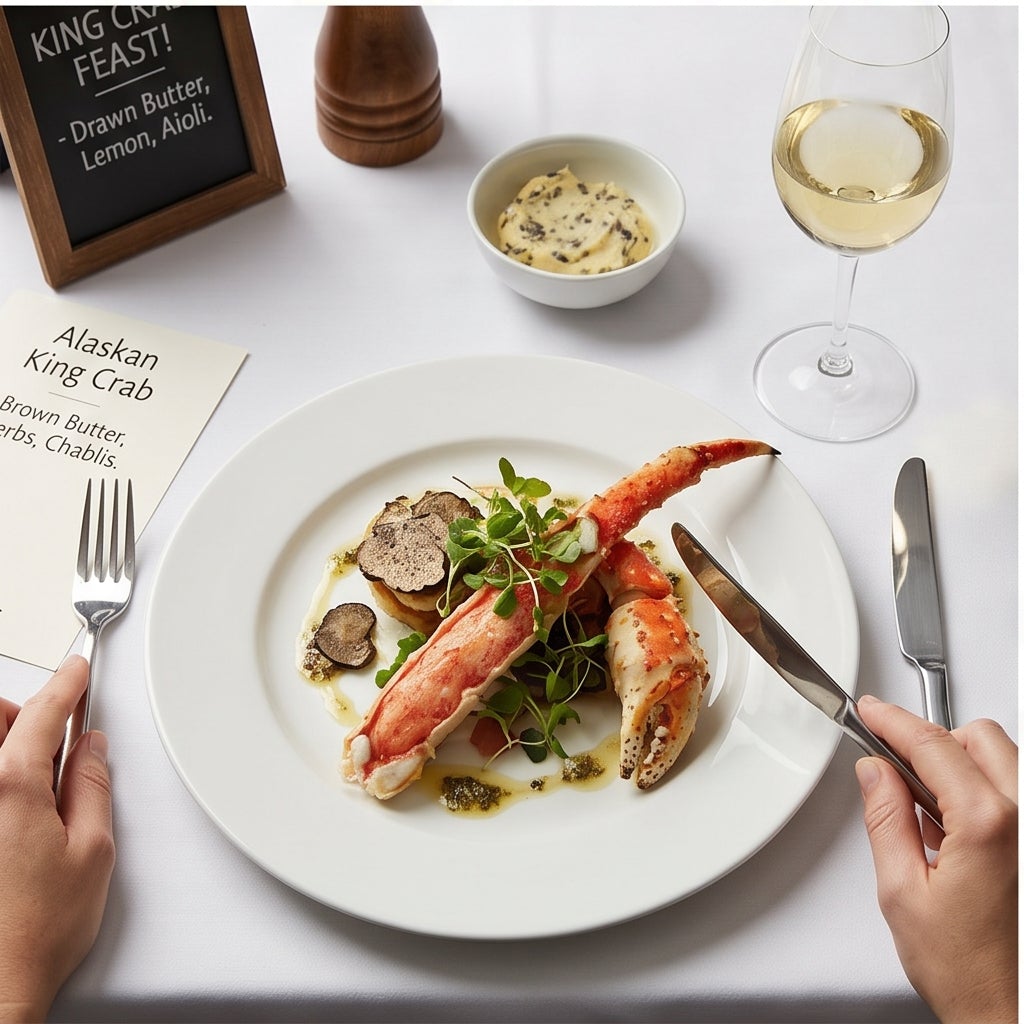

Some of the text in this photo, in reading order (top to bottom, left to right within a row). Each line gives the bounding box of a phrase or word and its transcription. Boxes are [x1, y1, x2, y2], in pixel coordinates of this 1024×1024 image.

[30, 8, 105, 63] KING
[73, 23, 172, 87] FEAST!
[69, 105, 138, 144] Drawn
[140, 76, 210, 116] Butter,
[80, 102, 213, 171] Lemon, Aioli.
[23, 348, 153, 401] King Crab
[52, 326, 159, 371] Alaskan
[0, 395, 126, 448] Brown Butter,
[45, 435, 117, 470] Chablis.
